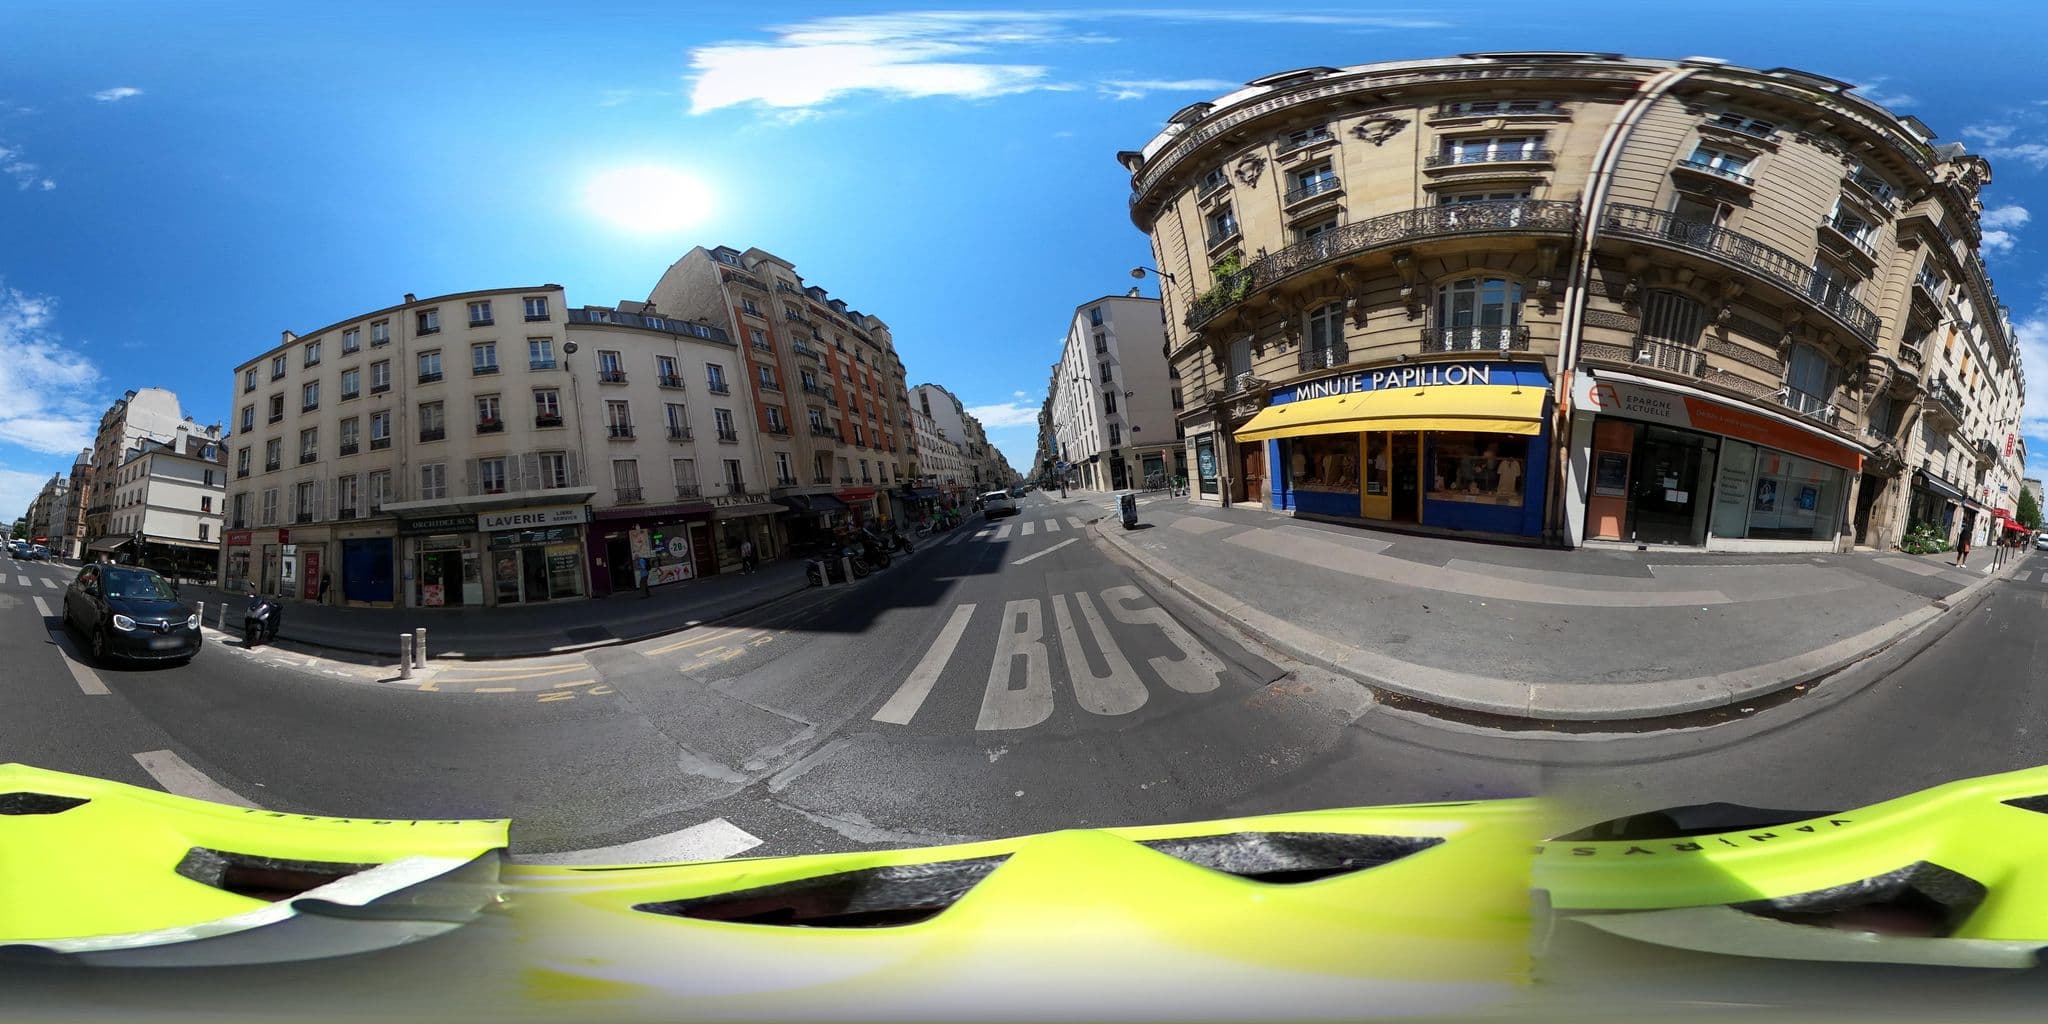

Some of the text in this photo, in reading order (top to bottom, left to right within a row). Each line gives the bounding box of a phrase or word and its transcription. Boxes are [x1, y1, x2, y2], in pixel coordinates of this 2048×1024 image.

[1296, 364, 1490, 402] MINUTE PAPILLON
[1625, 404, 1672, 418] ACTUELLE
[486, 513, 546, 527] LAVERIE
[974, 585, 1228, 731] BUS
